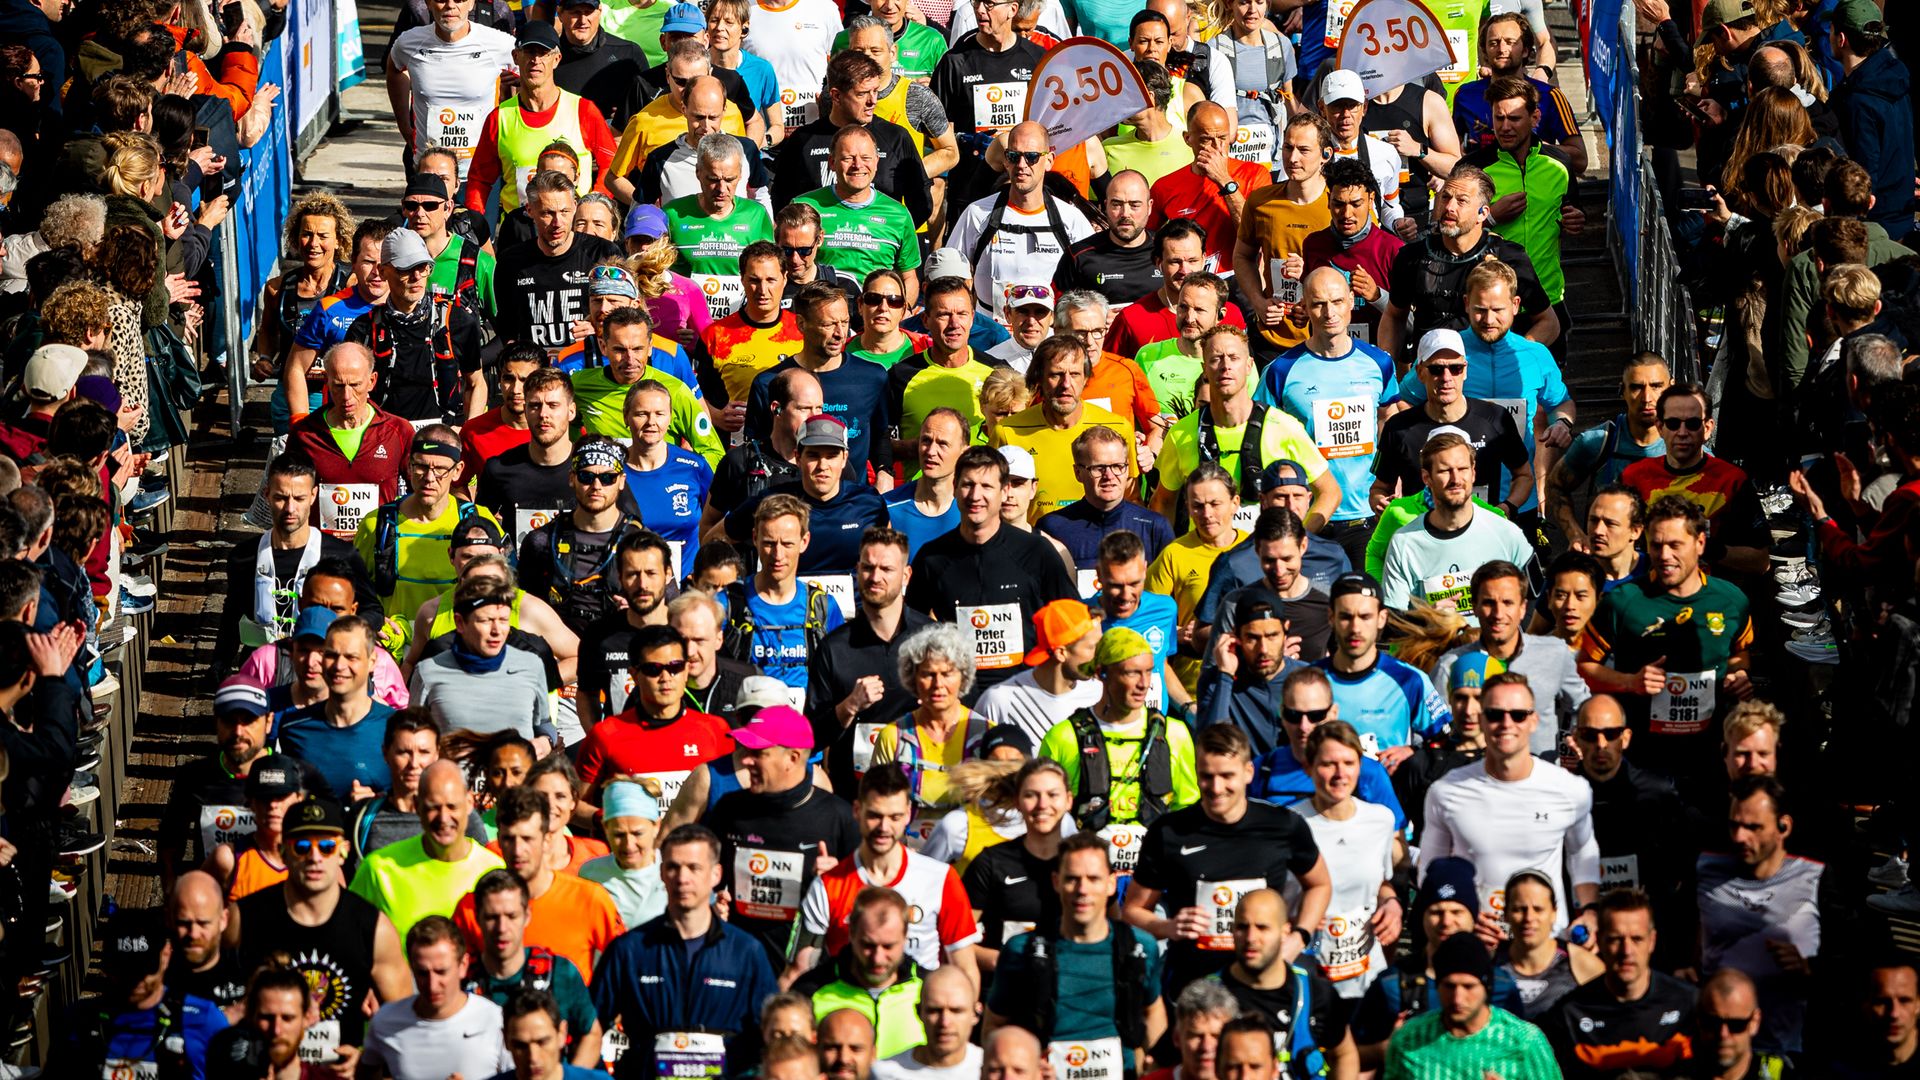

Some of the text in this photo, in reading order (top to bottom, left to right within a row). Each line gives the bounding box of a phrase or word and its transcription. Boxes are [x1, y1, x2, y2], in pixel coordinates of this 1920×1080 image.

[1357, 15, 1430, 56] 3.50
[963, 74, 984, 83] HOKA
[1044, 61, 1123, 111] 3.50
[1005, 89, 1021, 98] NN
[785, 105, 805, 115] Sam
[991, 103, 1014, 113] Barn
[458, 113, 474, 121] NN
[990, 113, 1016, 126] 4851
[442, 125, 466, 136] Auke
[1252, 130, 1267, 138] NN
[439, 136, 469, 148] 10478
[810, 147, 830, 156] HOKA
[699, 242, 738, 251] ROTTERDAM
[722, 283, 739, 291] NN
[707, 295, 730, 306] Henk
[527, 289, 584, 324] WE
[822, 403, 848, 412] Bertus
[1347, 404, 1365, 414] NN
[1328, 420, 1361, 432] Jasper
[1332, 431, 1360, 445] 1064
[352, 491, 371, 499] NN
[337, 505, 360, 516] Nico
[1233, 511, 1251, 520] NN
[1456, 574, 1470, 582] NN
[826, 584, 844, 593] NN
[992, 612, 1012, 622] NN
[975, 629, 1004, 640] Peter
[975, 640, 1006, 655] 4739
[605, 652, 629, 661] HOKA
[1689, 680, 1708, 690] NN
[1670, 695, 1699, 707] Niels
[1669, 708, 1699, 721] 9181
[771, 861, 792, 872] NN
[1607, 863, 1628, 875] NN
[751, 889, 782, 906] 9337
[308, 1031, 329, 1040] NN
[1067, 1067, 1108, 1079] Fabian
